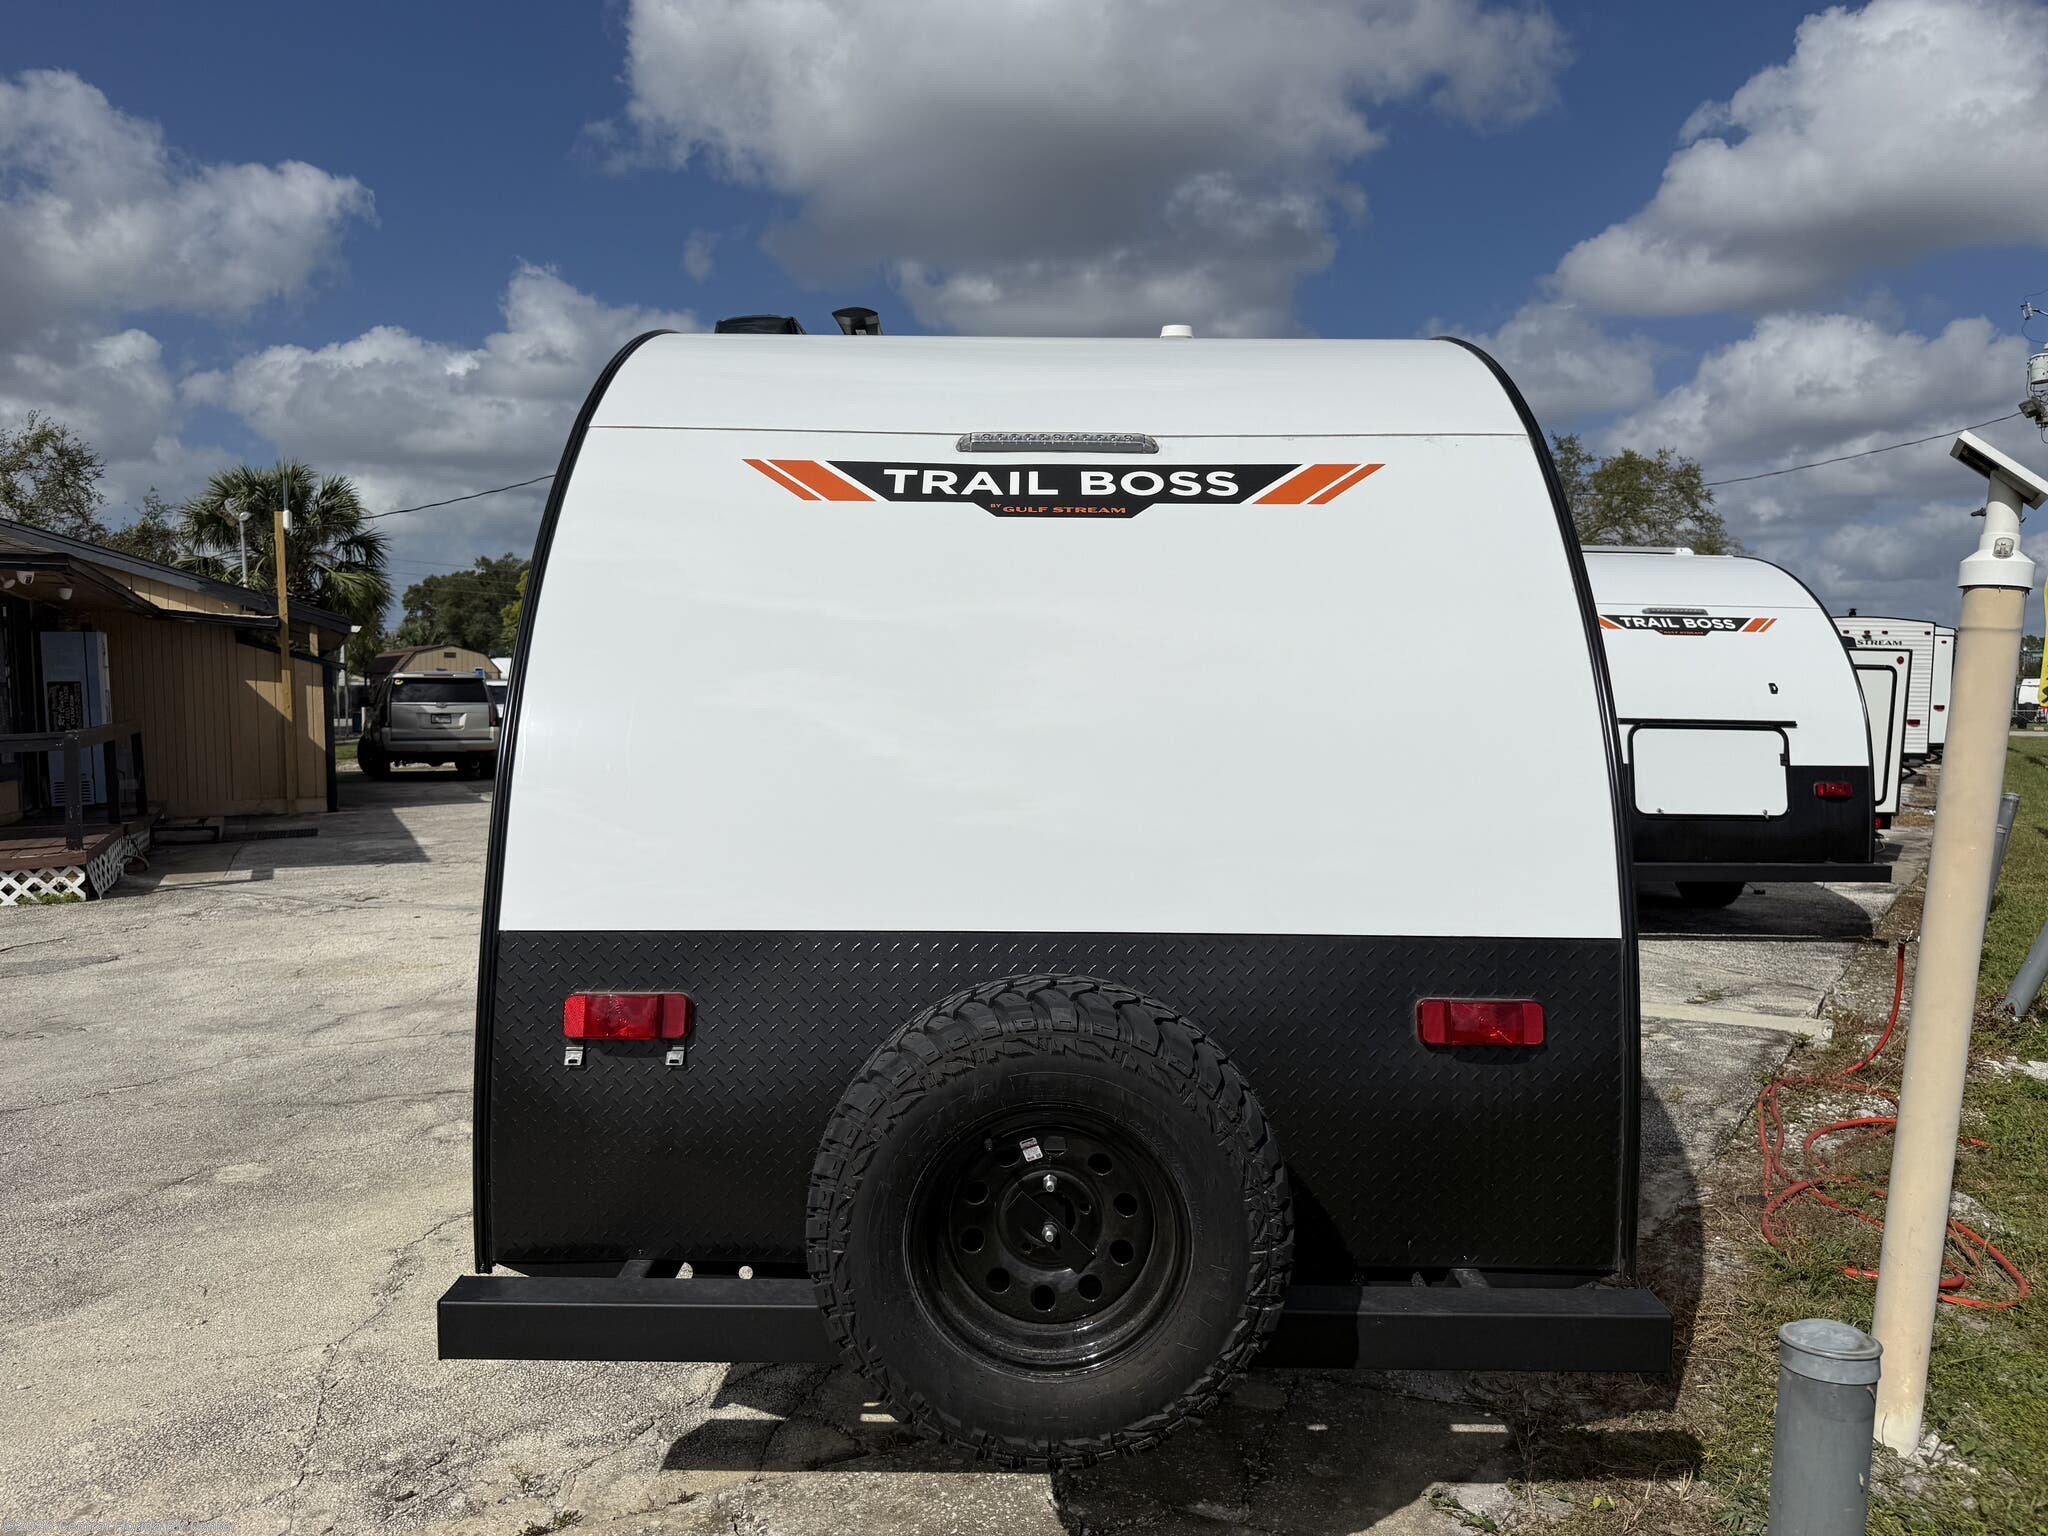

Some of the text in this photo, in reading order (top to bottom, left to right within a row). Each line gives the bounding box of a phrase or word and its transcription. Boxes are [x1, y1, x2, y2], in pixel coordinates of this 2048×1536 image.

[884, 469, 1240, 497] TRAIL BOSS
[1619, 617, 1736, 629] TRAIL BOSS
